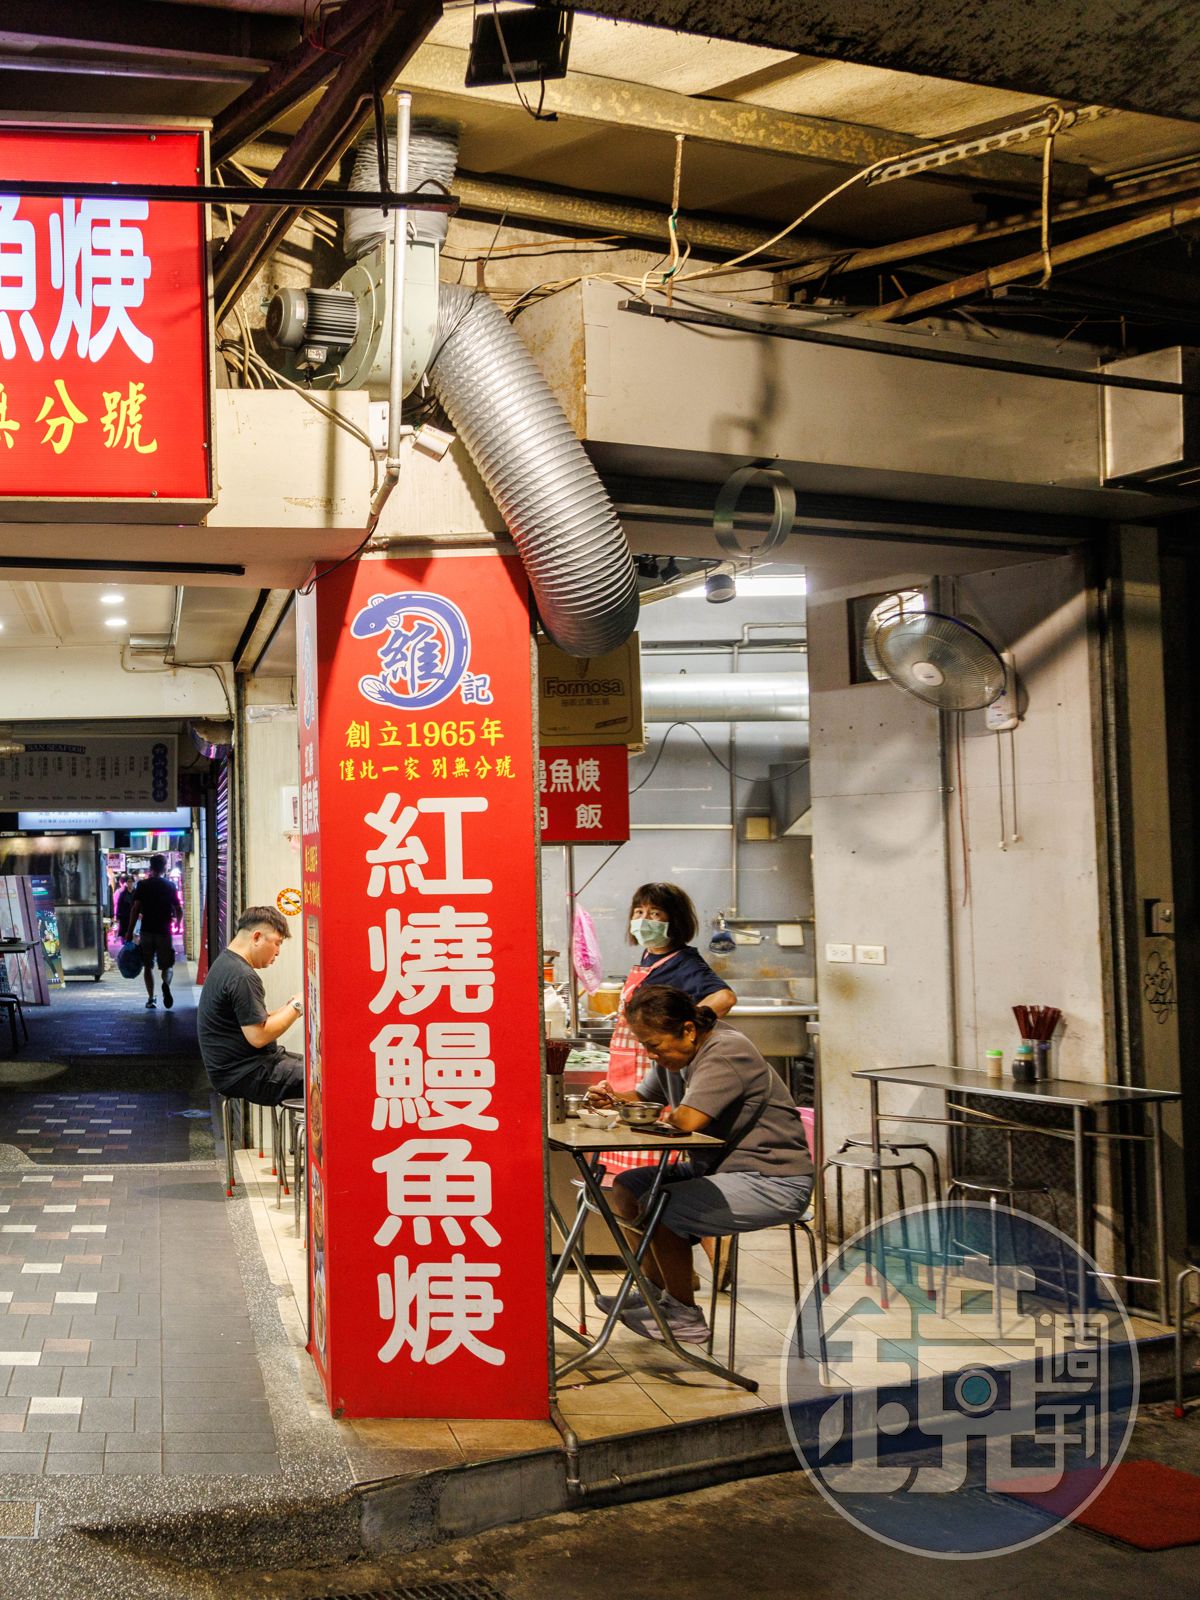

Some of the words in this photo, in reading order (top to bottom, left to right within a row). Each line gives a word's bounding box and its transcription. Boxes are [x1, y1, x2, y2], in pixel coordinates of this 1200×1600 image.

[545, 678, 622, 697] Formosa
[345, 717, 505, 748] 創立1965年
[339, 757, 421, 782] 僅此一家
[432, 755, 516, 780] 別無分號
[363, 792, 506, 1366] 紅燒鰻魚焿
